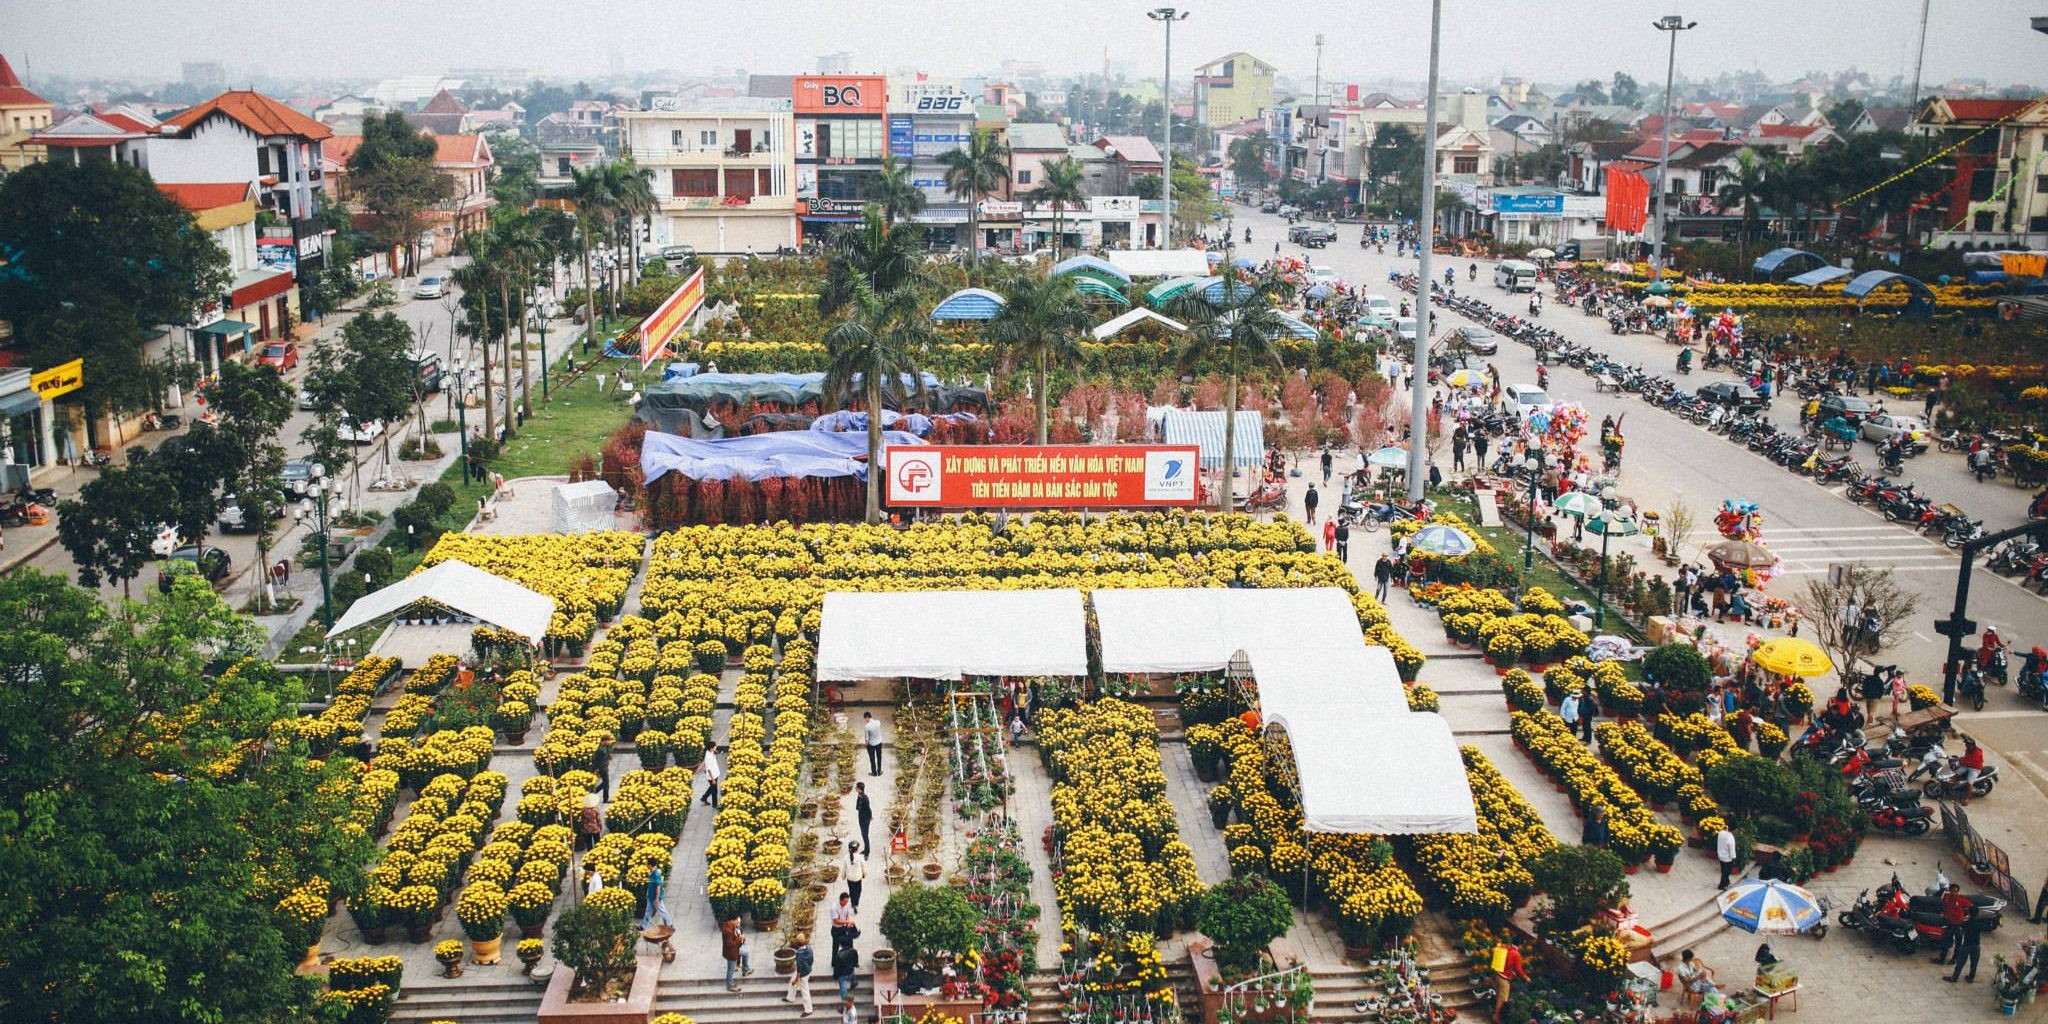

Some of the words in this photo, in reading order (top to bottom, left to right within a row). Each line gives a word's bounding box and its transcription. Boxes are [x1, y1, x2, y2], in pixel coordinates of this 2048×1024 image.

[823, 85, 862, 107] BQ
[917, 97, 962, 110] BBG
[808, 197, 833, 211] BQ
[945, 455, 962, 474] XÂY
[963, 456, 986, 476] DỰNG
[988, 455, 999, 474] VÀ
[1001, 454, 1022, 474] PHÁT
[1068, 454, 1085, 473] VĂN
[1087, 453, 1104, 473] HÓA
[1105, 454, 1123, 476] VIỆT
[1125, 457, 1144, 473] NAM
[971, 479, 990, 498] TIÊN
[992, 477, 1010, 498] TIẾN
[1011, 480, 1031, 501] ĐẬM
[1032, 479, 1044, 498] ĐÀ
[1045, 476, 1063, 498] BẢN
[1064, 477, 1081, 498] SẮC
[1083, 479, 1101, 498] DÂN
[1102, 478, 1118, 501] TỘC
